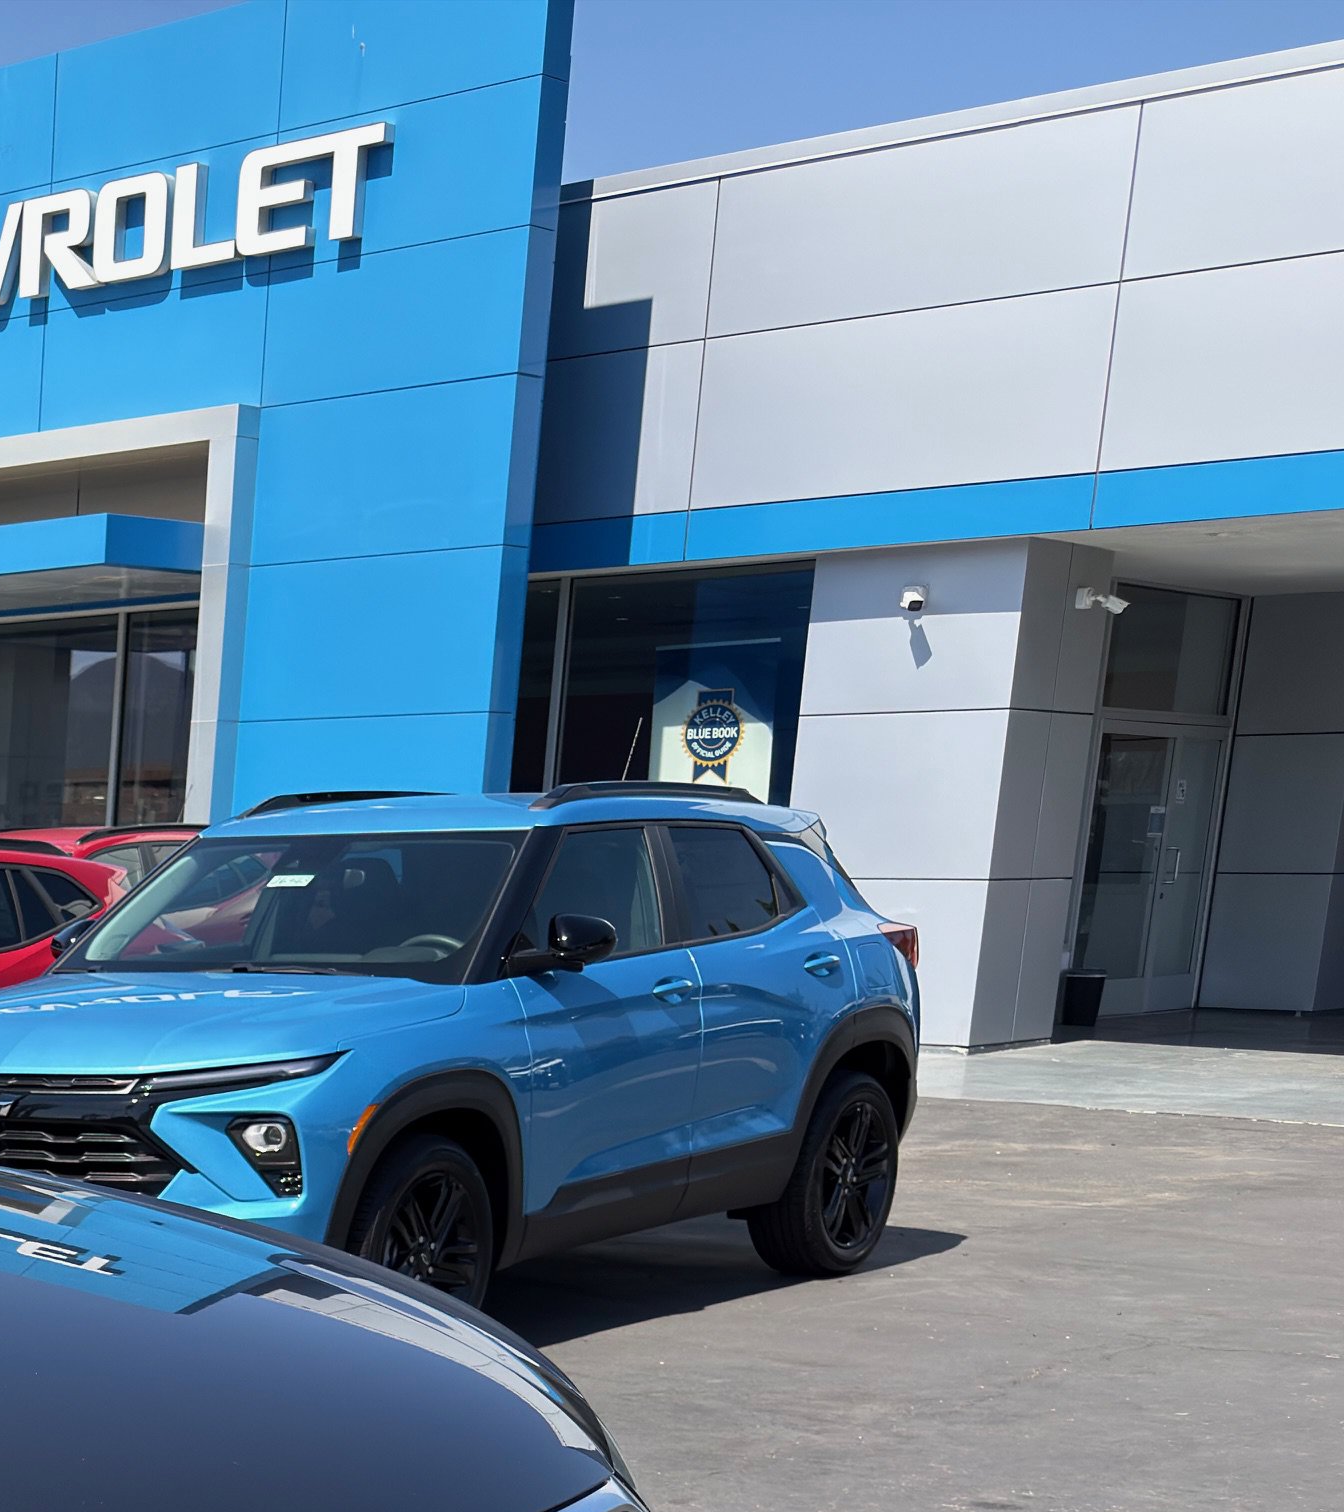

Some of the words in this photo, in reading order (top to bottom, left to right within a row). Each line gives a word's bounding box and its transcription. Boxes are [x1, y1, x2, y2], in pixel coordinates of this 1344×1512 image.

[694, 707, 736, 725] KELLEY
[687, 728, 712, 740] BLUE
[712, 727, 738, 739] BOOK
[691, 742, 714, 758] OFFICIAL
[715, 741, 732, 757] GUIDE
